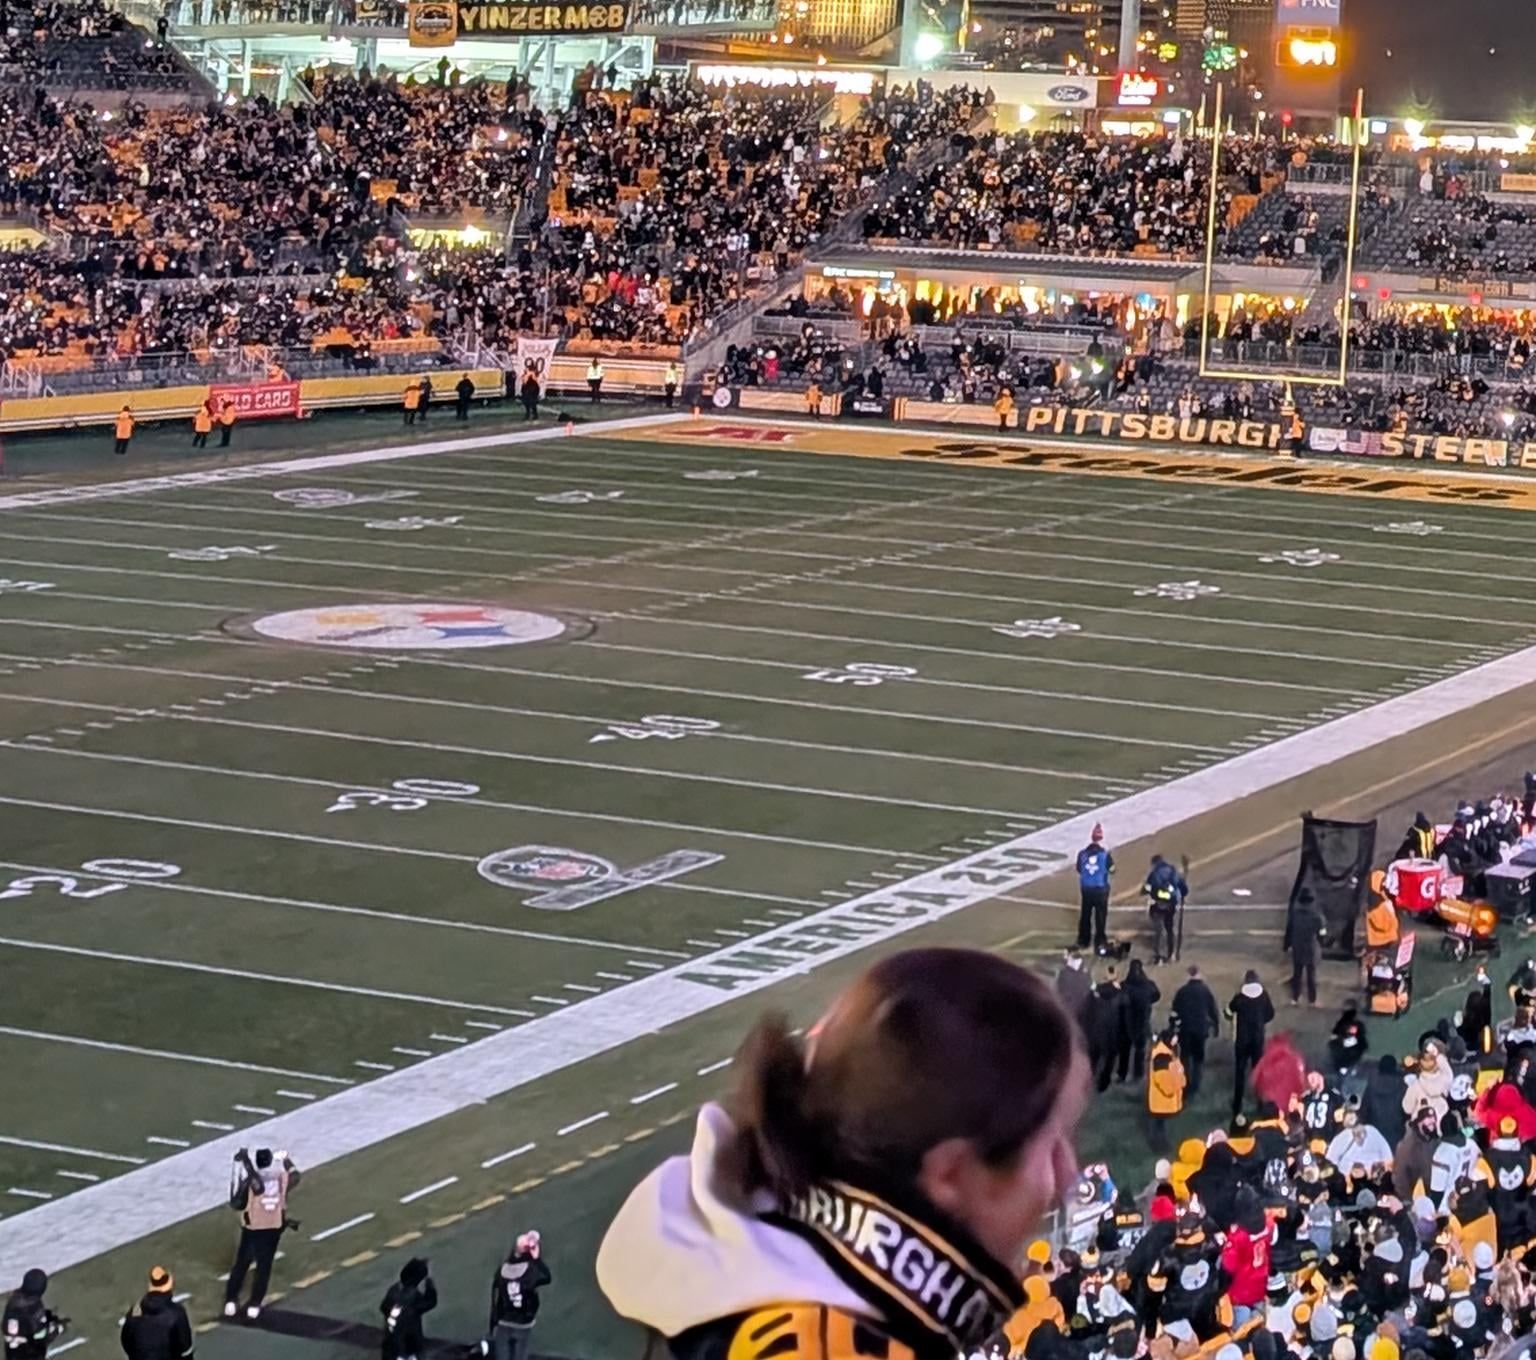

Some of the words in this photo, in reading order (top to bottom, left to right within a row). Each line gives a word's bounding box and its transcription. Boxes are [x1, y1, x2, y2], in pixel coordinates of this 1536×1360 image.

[254, 390, 291, 410] CARD
[676, 890, 968, 991] AMERICA
[942, 846, 1069, 885] 250
[1306, 1103, 1328, 1129] 43
[790, 1184, 965, 1321] BURGH
